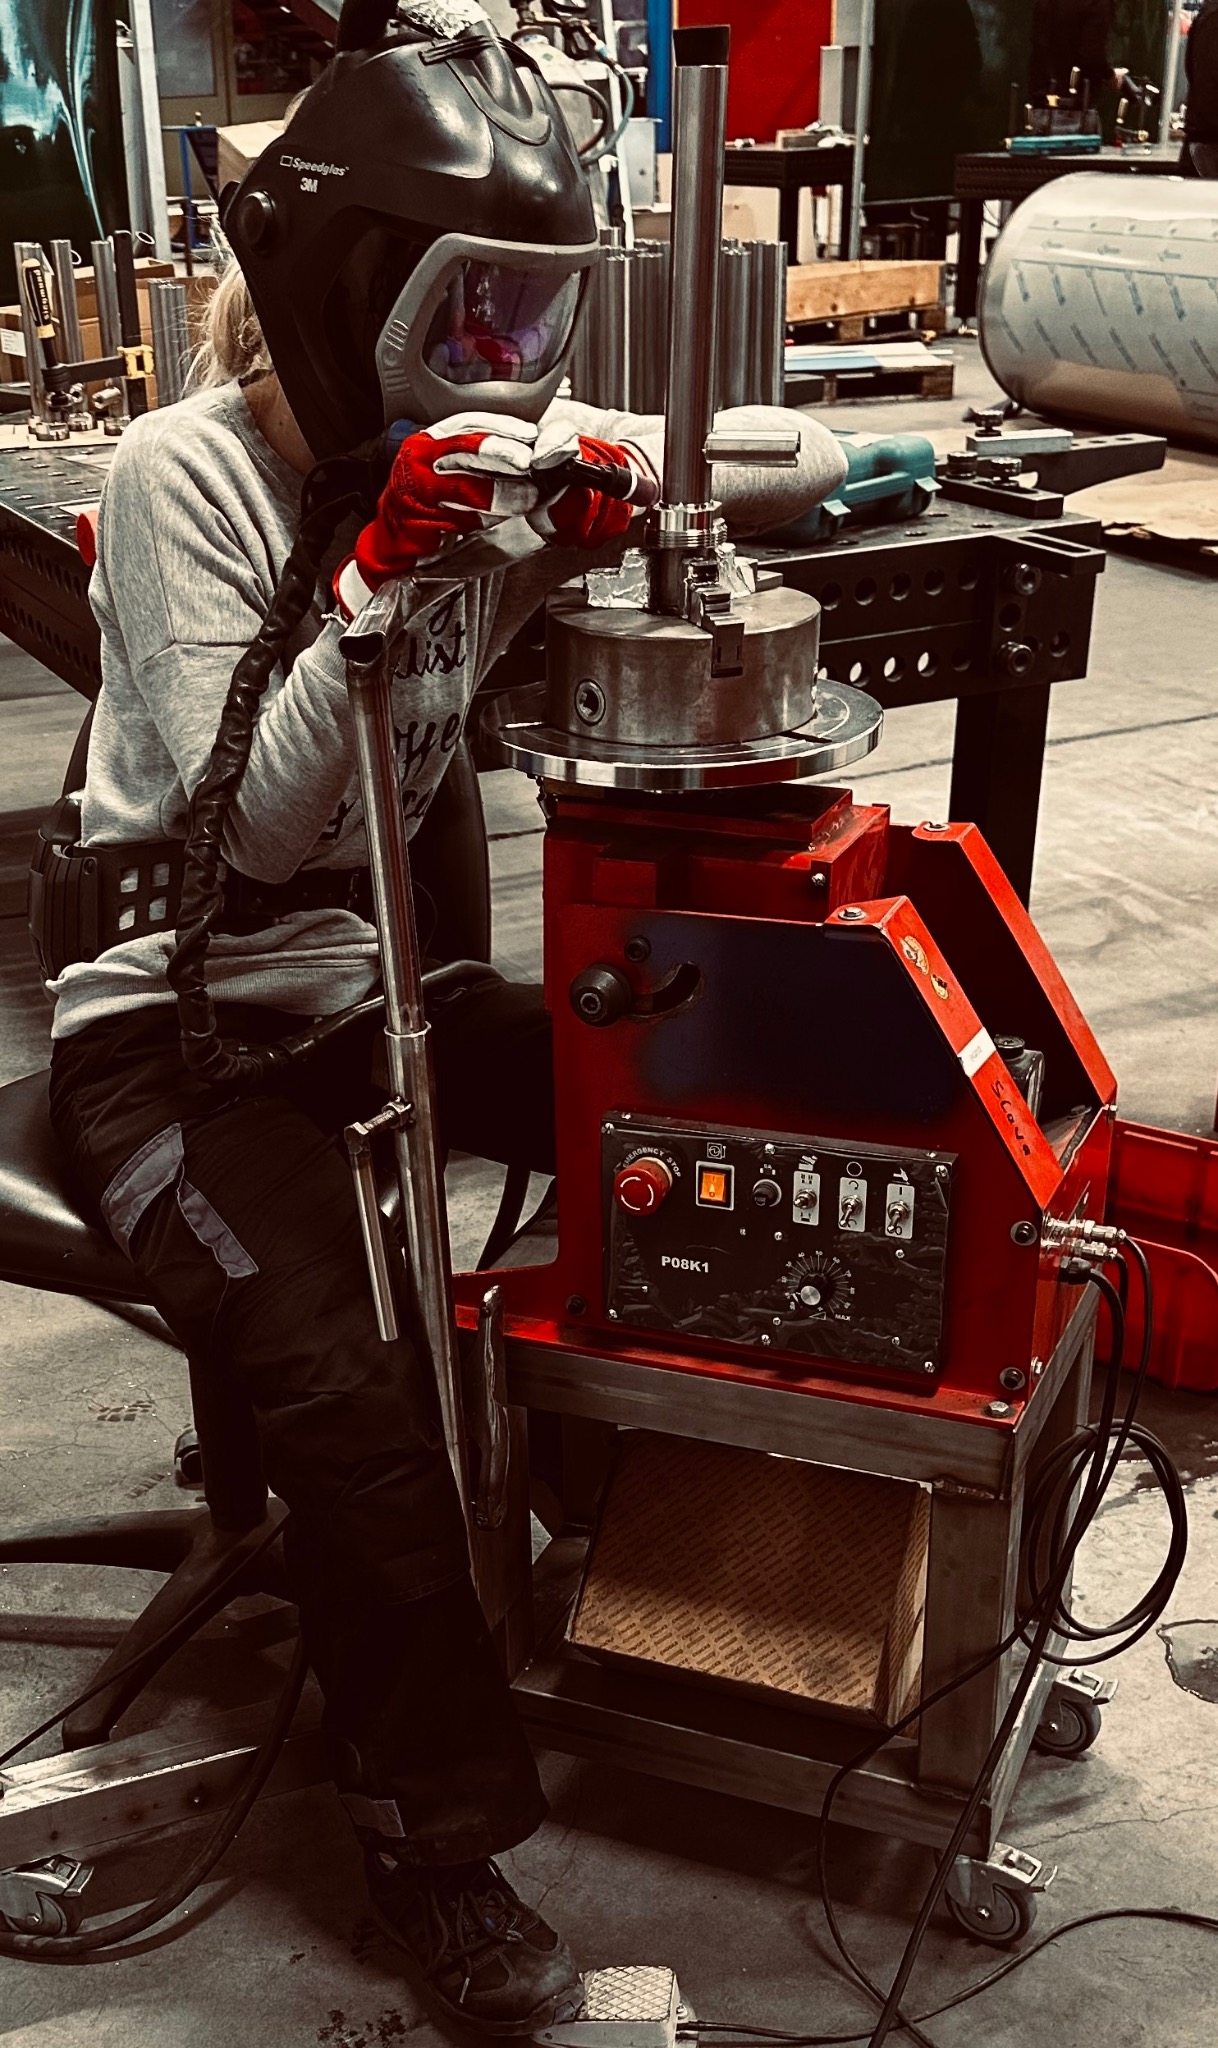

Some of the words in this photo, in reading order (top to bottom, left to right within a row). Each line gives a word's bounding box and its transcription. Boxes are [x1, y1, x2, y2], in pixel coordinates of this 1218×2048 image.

[292, 157, 346, 176] Speedglas
[300, 176, 319, 194] 3M
[666, 1156, 682, 1177] STOP
[661, 1255, 709, 1273] P08K1
[834, 1313, 851, 1321] MAX
